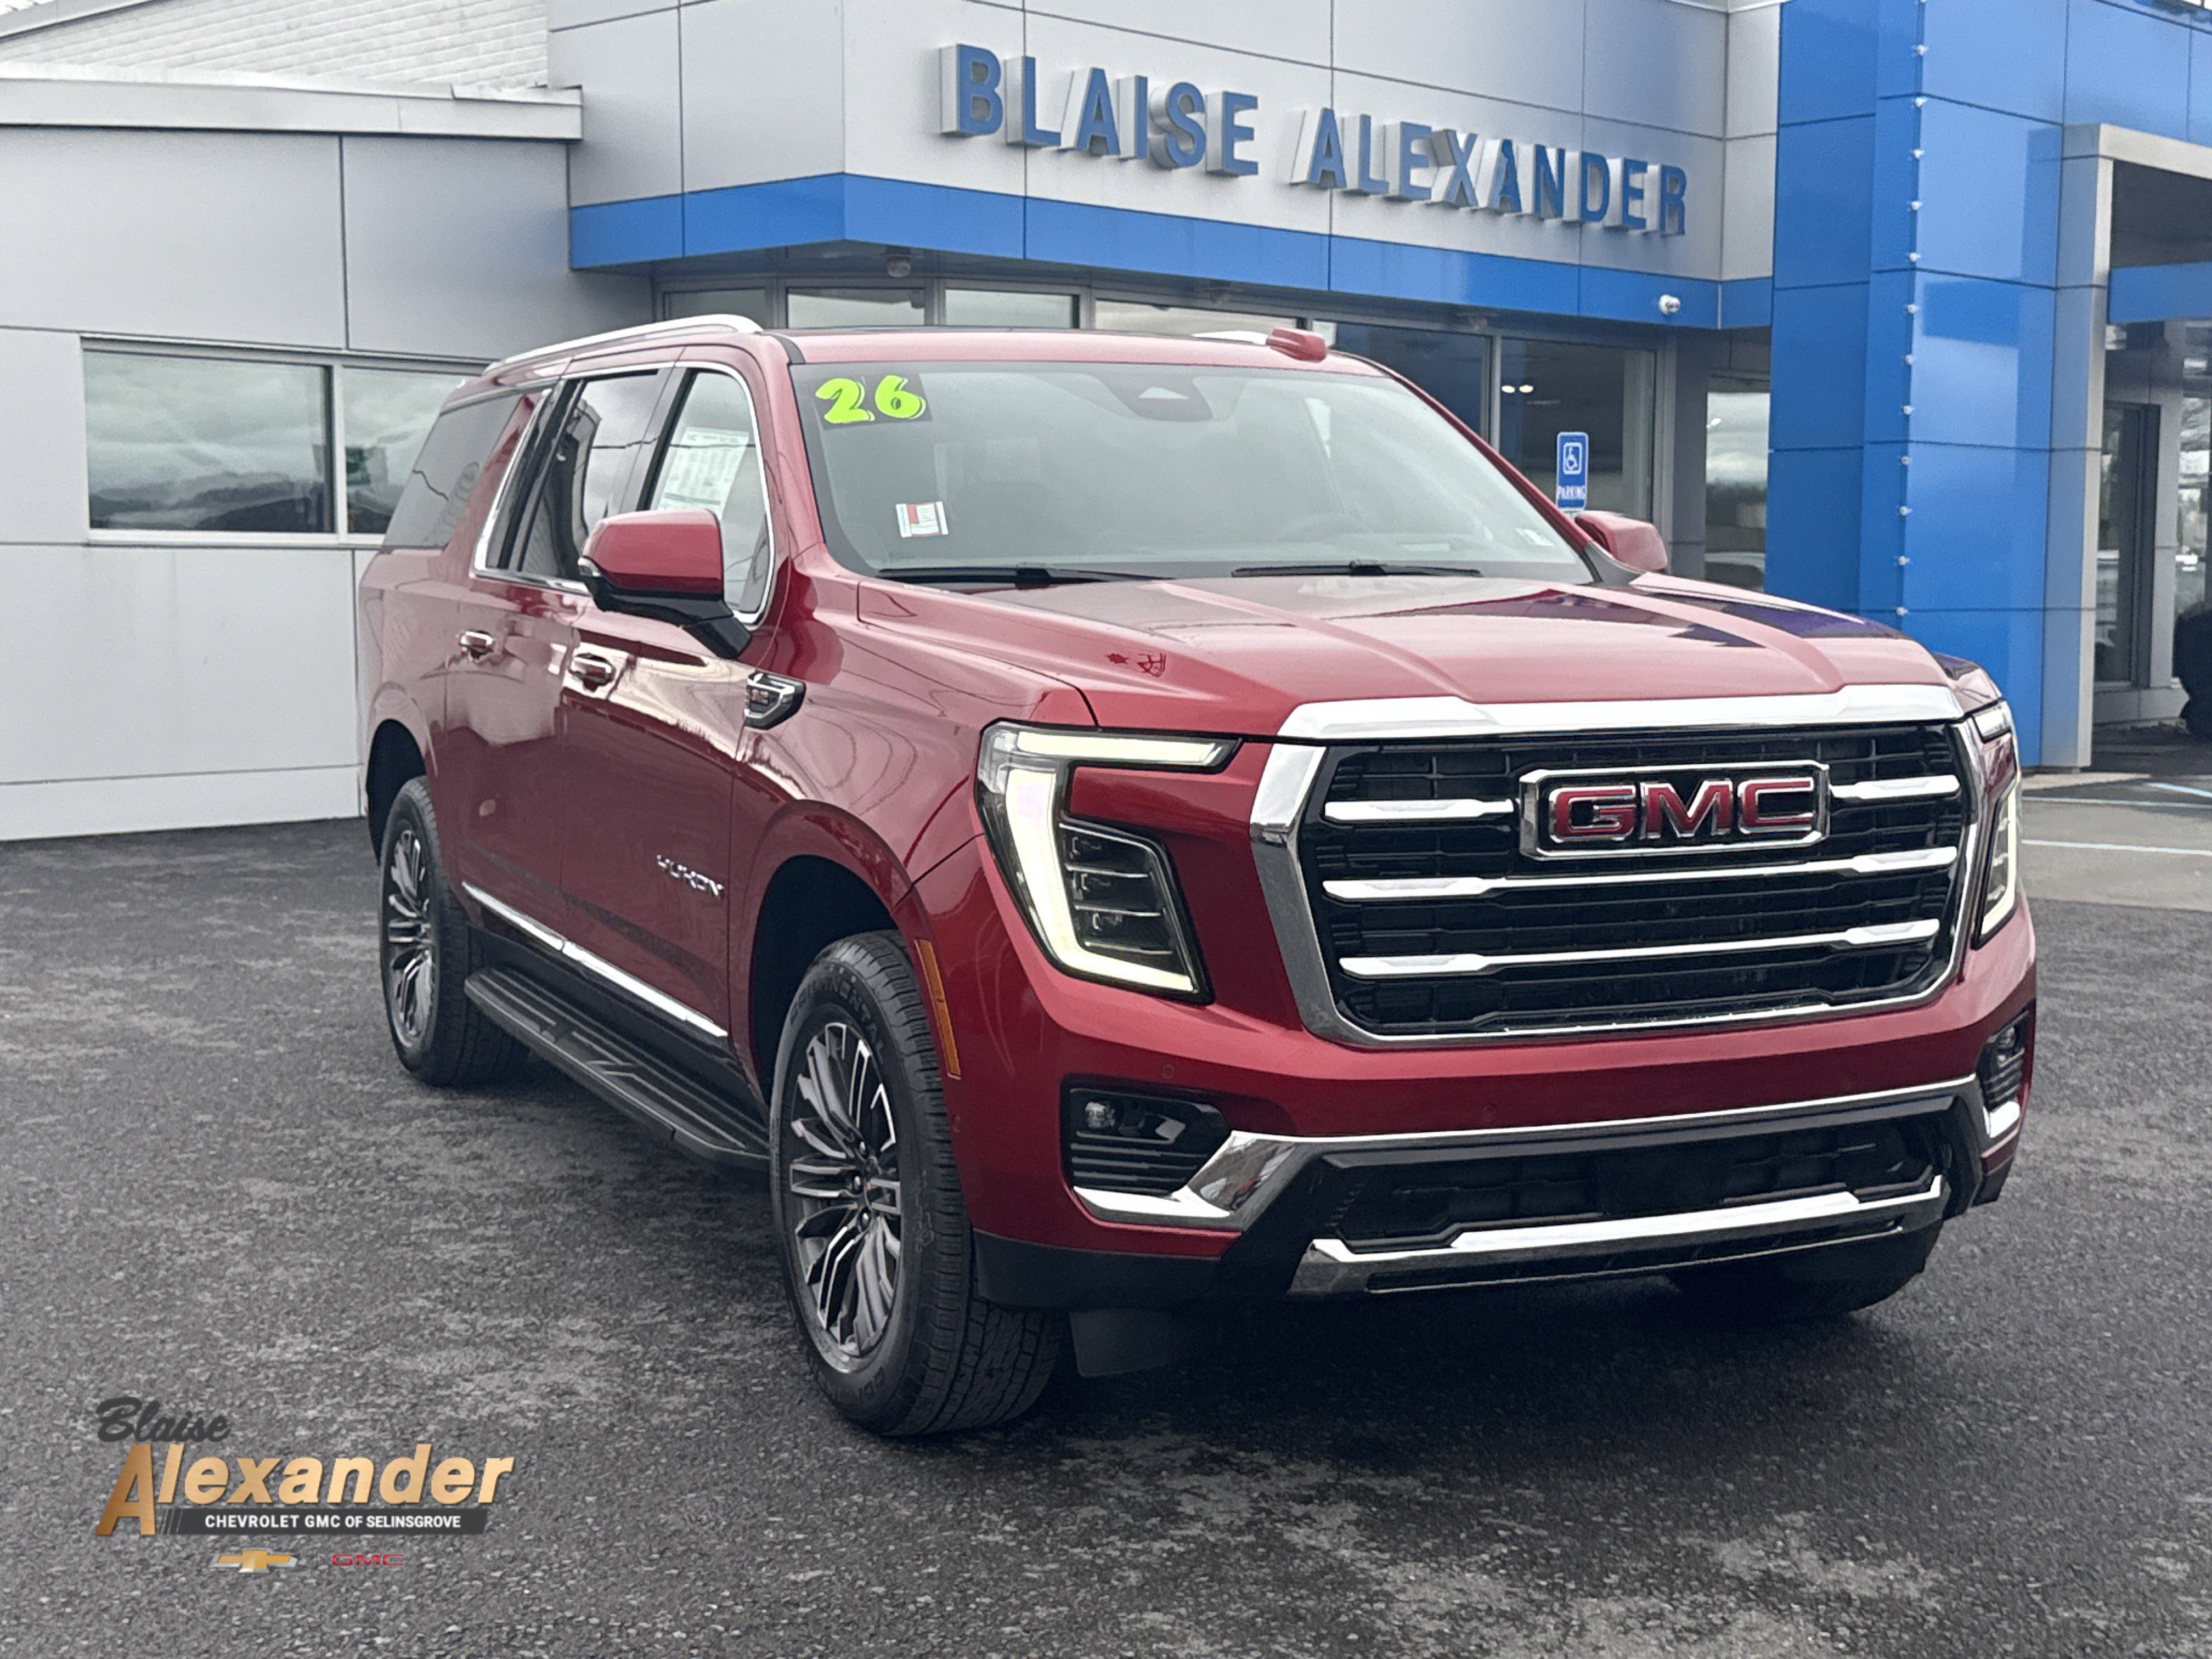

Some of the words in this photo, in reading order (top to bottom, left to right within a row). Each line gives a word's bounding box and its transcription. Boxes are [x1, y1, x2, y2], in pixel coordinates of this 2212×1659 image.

[941, 43, 1259, 177] BLAISE
[1294, 108, 1688, 236] ALEXANDER
[815, 375, 926, 424] 26
[1548, 776, 1814, 843] GMC
